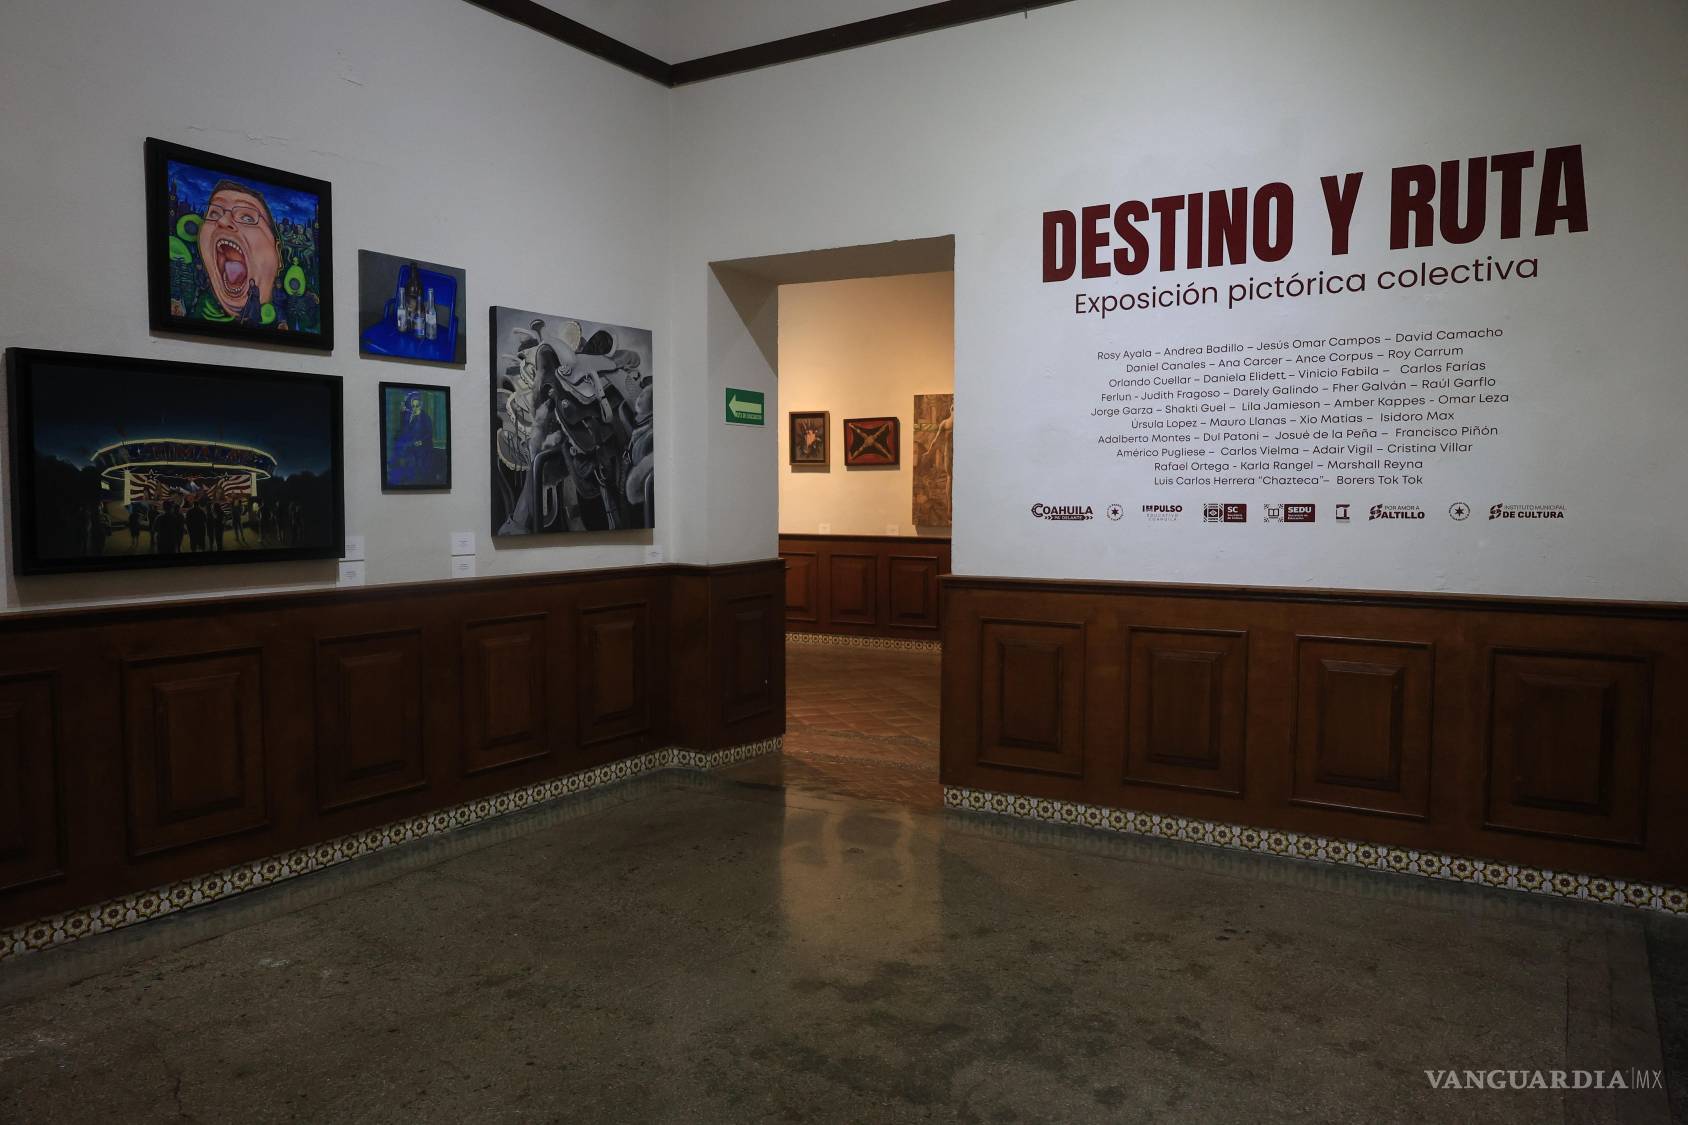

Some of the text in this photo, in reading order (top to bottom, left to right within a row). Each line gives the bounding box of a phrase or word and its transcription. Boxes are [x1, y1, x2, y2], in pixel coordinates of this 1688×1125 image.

[1043, 144, 1589, 283] DESTINO Y RUTA
[1075, 255, 1538, 319] Exposición pictórica colectiva
[1097, 351, 1121, 361] Rosy
[1122, 349, 1152, 361] Ayala
[1163, 346, 1203, 357] Andrea
[1206, 343, 1244, 354] Badillo
[1255, 340, 1290, 351] Jesús
[1292, 339, 1326, 349] Omar
[1328, 336, 1381, 347] Campos
[1395, 331, 1433, 343] David
[1436, 327, 1503, 340] Camacho
[1126, 362, 1159, 373] Daniel
[1161, 360, 1206, 371] Canales
[1218, 359, 1240, 368] Ana
[1243, 357, 1284, 367] Carcer
[1295, 354, 1326, 364] Ance
[1328, 352, 1374, 363] Corpus
[1388, 349, 1411, 360] Roy
[1414, 346, 1464, 358] Carrum
[1108, 377, 1152, 389] Orlando
[1153, 375, 1192, 386] Cuellar
[1203, 373, 1246, 384] Daniela
[1249, 371, 1287, 381] Elidett
[1298, 368, 1338, 379] Vinicio
[1341, 366, 1379, 377] Fabila
[1400, 363, 1442, 374] Carlos
[1446, 361, 1487, 372] Farías
[1101, 392, 1132, 402] Ferlun
[1140, 390, 1174, 401] Judith
[1177, 390, 1221, 401] Fragoso
[1233, 386, 1270, 398] Darely
[1272, 384, 1318, 395] Galindo
[1332, 383, 1359, 393] Fher
[1361, 380, 1407, 392] Galván
[1422, 378, 1450, 389] Raúl
[1090, 408, 1120, 418] Jorge
[1122, 406, 1153, 415] Garza
[1165, 404, 1198, 414] Shakti
[1200, 402, 1226, 413] Guel
[1242, 401, 1261, 411] Lila
[1263, 400, 1321, 411] Jamieson
[1333, 397, 1375, 408] Amber
[1377, 397, 1426, 408] Kappes
[1438, 394, 1476, 405] Omar
[1479, 393, 1509, 404] Leza
[1131, 418, 1164, 429] Úrsula
[1166, 419, 1198, 430] Lopez
[1209, 418, 1247, 427] Mauro
[1249, 416, 1287, 426] Llanas
[1299, 414, 1318, 425] Xio
[1320, 413, 1363, 424] Matias
[1380, 412, 1423, 423] Isidoro
[1426, 411, 1454, 421] Max
[1098, 434, 1149, 444] Adalberto
[1151, 434, 1191, 443] Montes
[1203, 432, 1221, 442] Dul
[1223, 431, 1259, 441] Patoni
[1274, 429, 1310, 440] Josué
[1312, 429, 1329, 440] de
[1332, 429, 1343, 439] la
[1346, 428, 1377, 439] Peña
[1395, 427, 1458, 438] Francisco
[1461, 425, 1498, 436] Piñón
[1116, 448, 1159, 458] Américo
[1161, 447, 1206, 459] Pugliese
[1220, 446, 1257, 456] Carlos
[1259, 445, 1299, 455] Vielma
[1312, 444, 1345, 455] Adair
[1347, 444, 1373, 456] Vigil
[1387, 443, 1437, 455] Cristina
[1440, 442, 1473, 454] Villar
[1154, 461, 1188, 472] Rafael
[1190, 462, 1230, 473] Ortega
[1240, 460, 1270, 471] Karla
[1273, 460, 1314, 472] Rangel
[1327, 459, 1380, 470] Marshall
[1384, 459, 1423, 471] Reyna
[1154, 476, 1174, 486] Luis
[1175, 476, 1211, 486] Carlos
[1211, 476, 1255, 486] Herrera
[1336, 475, 1375, 485] Borers
[1377, 475, 1399, 485] Tok
[1401, 475, 1423, 485] Tok
[1031, 503, 1093, 517] COAHUILA
